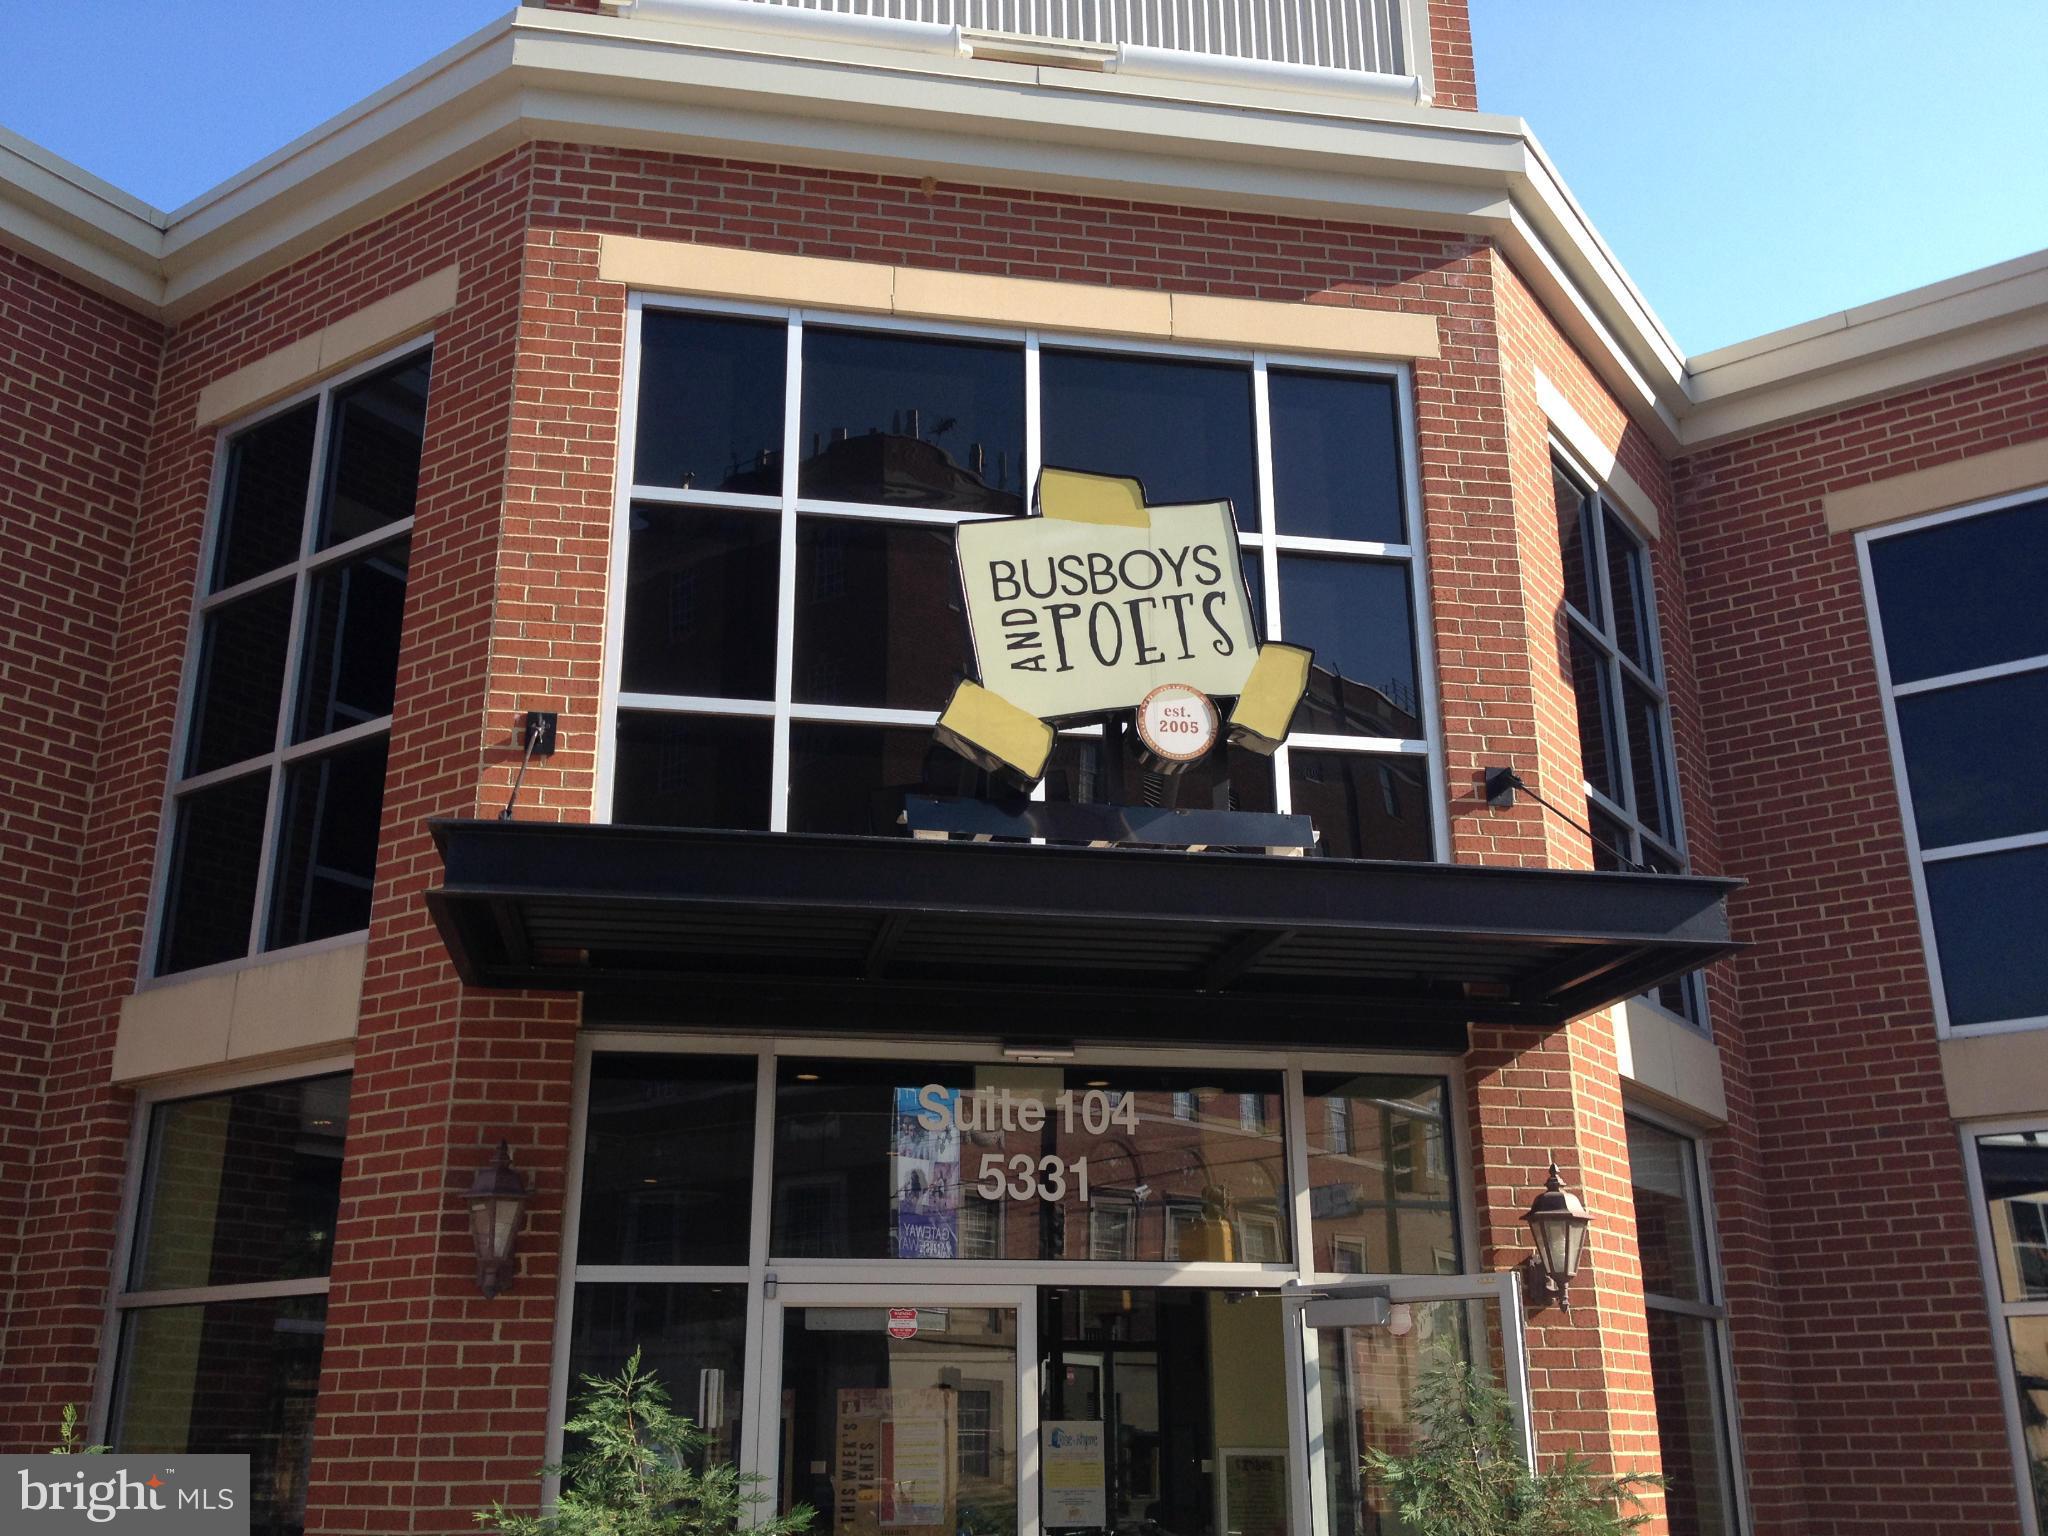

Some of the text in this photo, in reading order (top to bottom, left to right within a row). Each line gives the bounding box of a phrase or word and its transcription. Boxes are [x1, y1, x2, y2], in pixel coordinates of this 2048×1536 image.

[989, 544, 1222, 602] BUSBOYS
[1000, 608, 1047, 672] AND
[1042, 591, 1235, 672] POETS
[1159, 720, 1199, 734] 2005
[1164, 706, 1191, 717] est.
[917, 1083, 1140, 1135] Suite 104
[977, 1153, 1089, 1202] 5331
[841, 1423, 858, 1523] THIS WEEK'S
[858, 1442, 874, 1501] EVENTS
